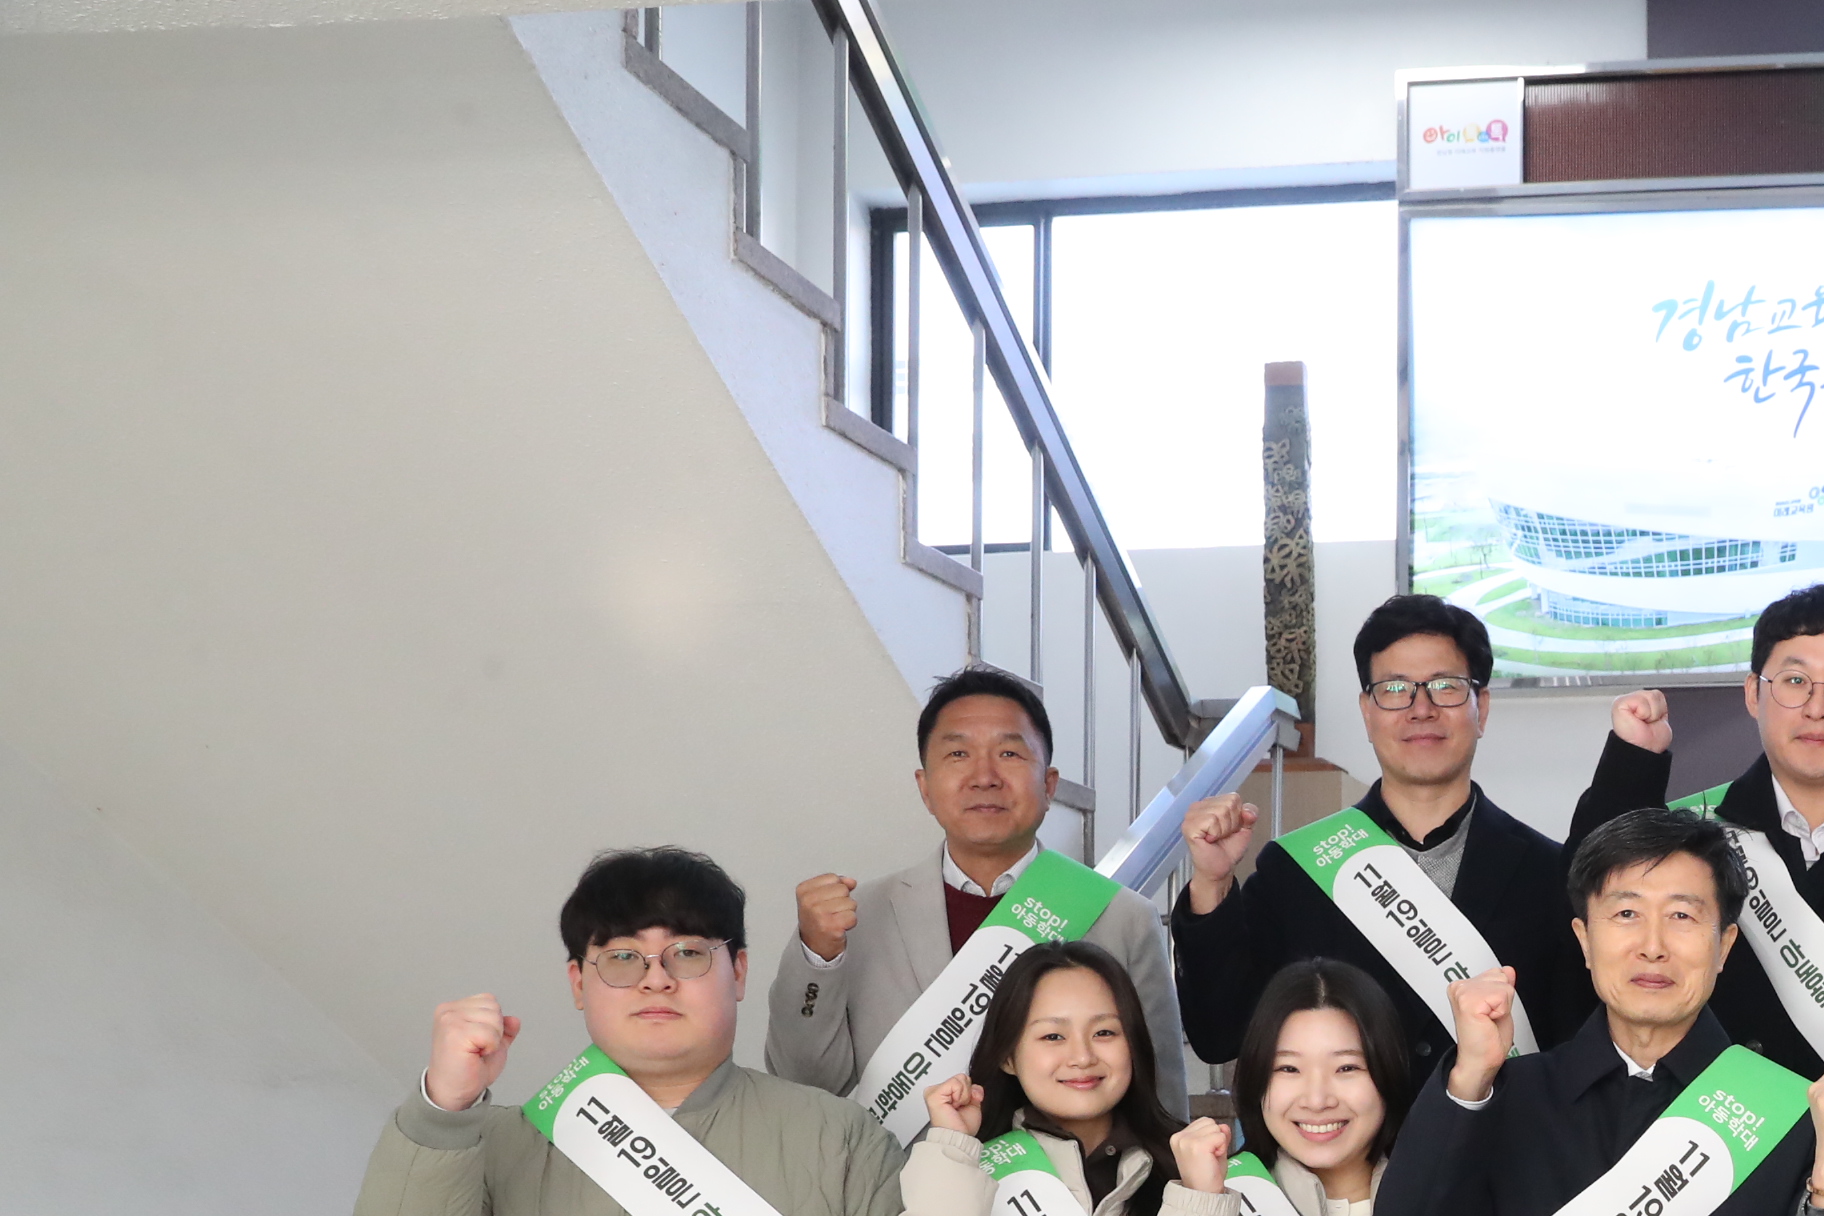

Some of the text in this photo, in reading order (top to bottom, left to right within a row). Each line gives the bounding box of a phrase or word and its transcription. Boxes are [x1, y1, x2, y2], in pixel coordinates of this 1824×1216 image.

[1313, 824, 1355, 855] stop!
[1316, 828, 1369, 867] 아동학대
[1024, 896, 1069, 932] stop!
[538, 1056, 590, 1110] 아동학대
[1698, 1095, 1759, 1152] 아동학대
[1713, 1089, 1765, 1131] stop!
